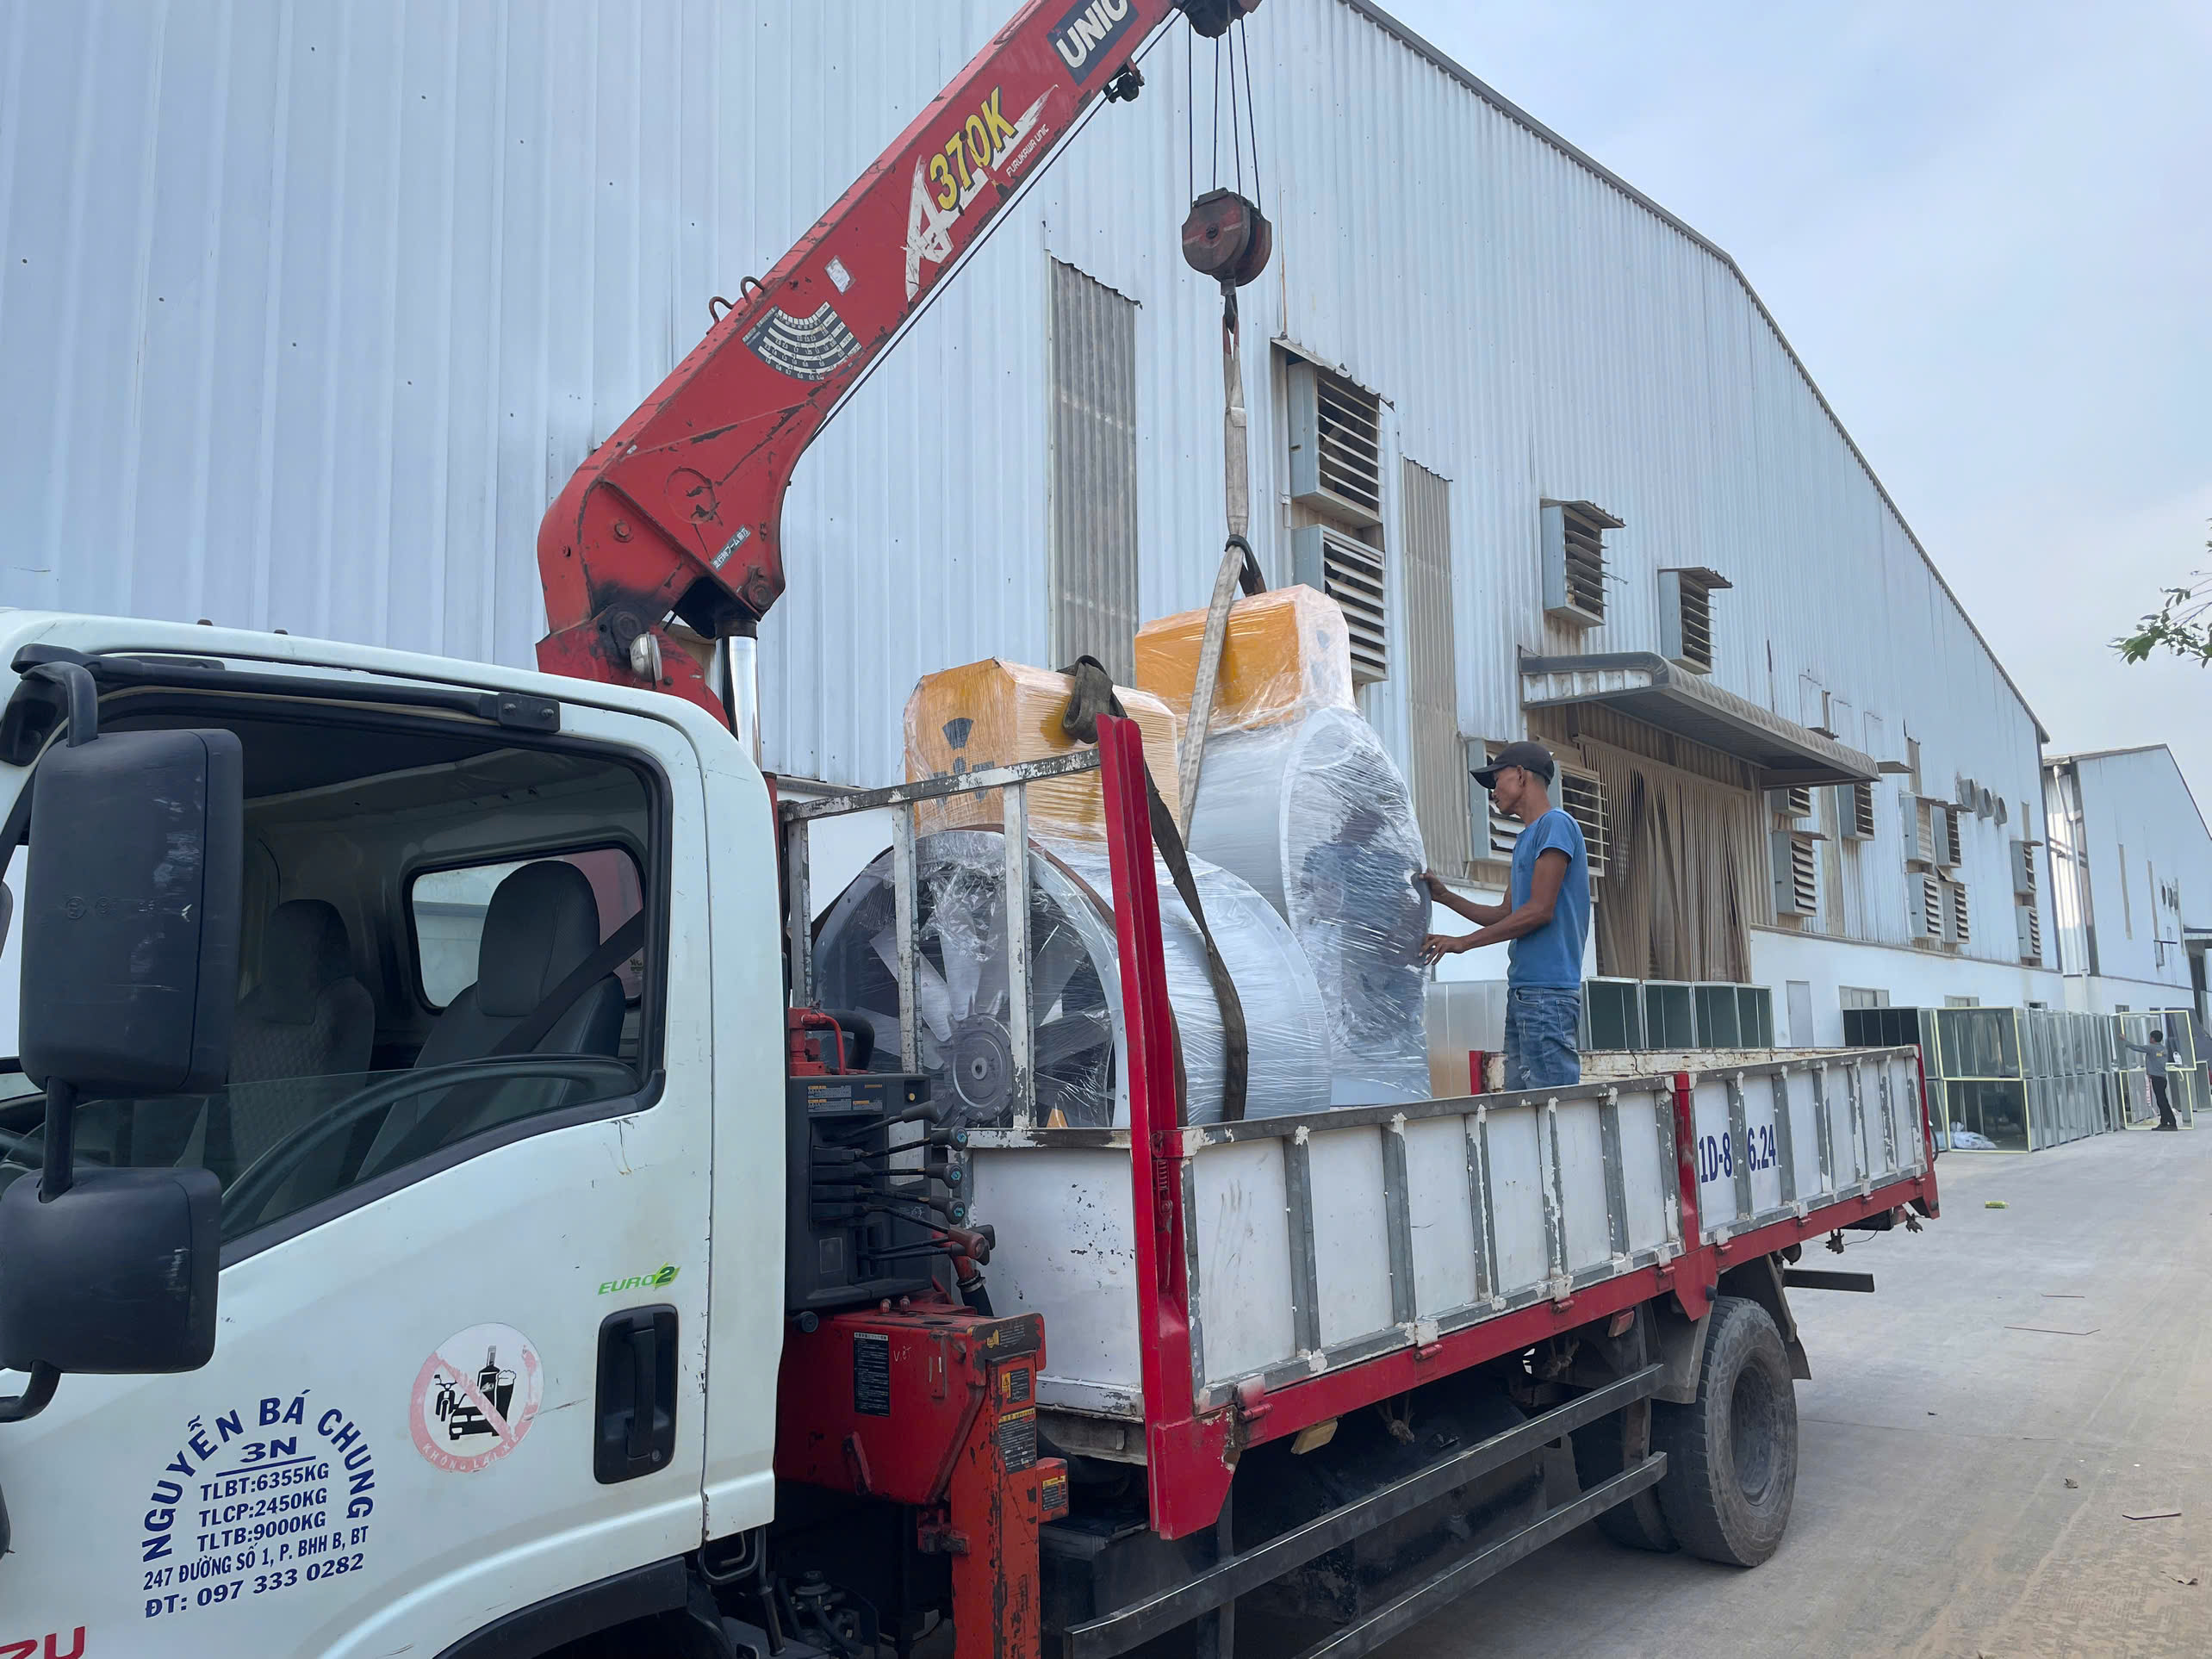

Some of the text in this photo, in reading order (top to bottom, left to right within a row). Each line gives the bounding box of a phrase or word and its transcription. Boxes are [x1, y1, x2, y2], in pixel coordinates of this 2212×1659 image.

[1056, 0, 1128, 68] UNIC
[929, 86, 1018, 211] 370K
[1005, 123, 1049, 177] FURUKAWA UNIC
[142, 1389, 376, 1563] NGUYỄN BÁ CHUNG
[239, 1436, 297, 1463] 3N
[198, 1488, 328, 1528] TLCP:2450KG
[200, 1463, 330, 1501] TLBT:6355KG
[143, 1525, 370, 1590] 247 ĐƯỜNG SỐ 1, P. BHH B, BT
[196, 1511, 326, 1552] TLTB:9000KG
[145, 1553, 364, 1619] ĐT: 097 333 0282
